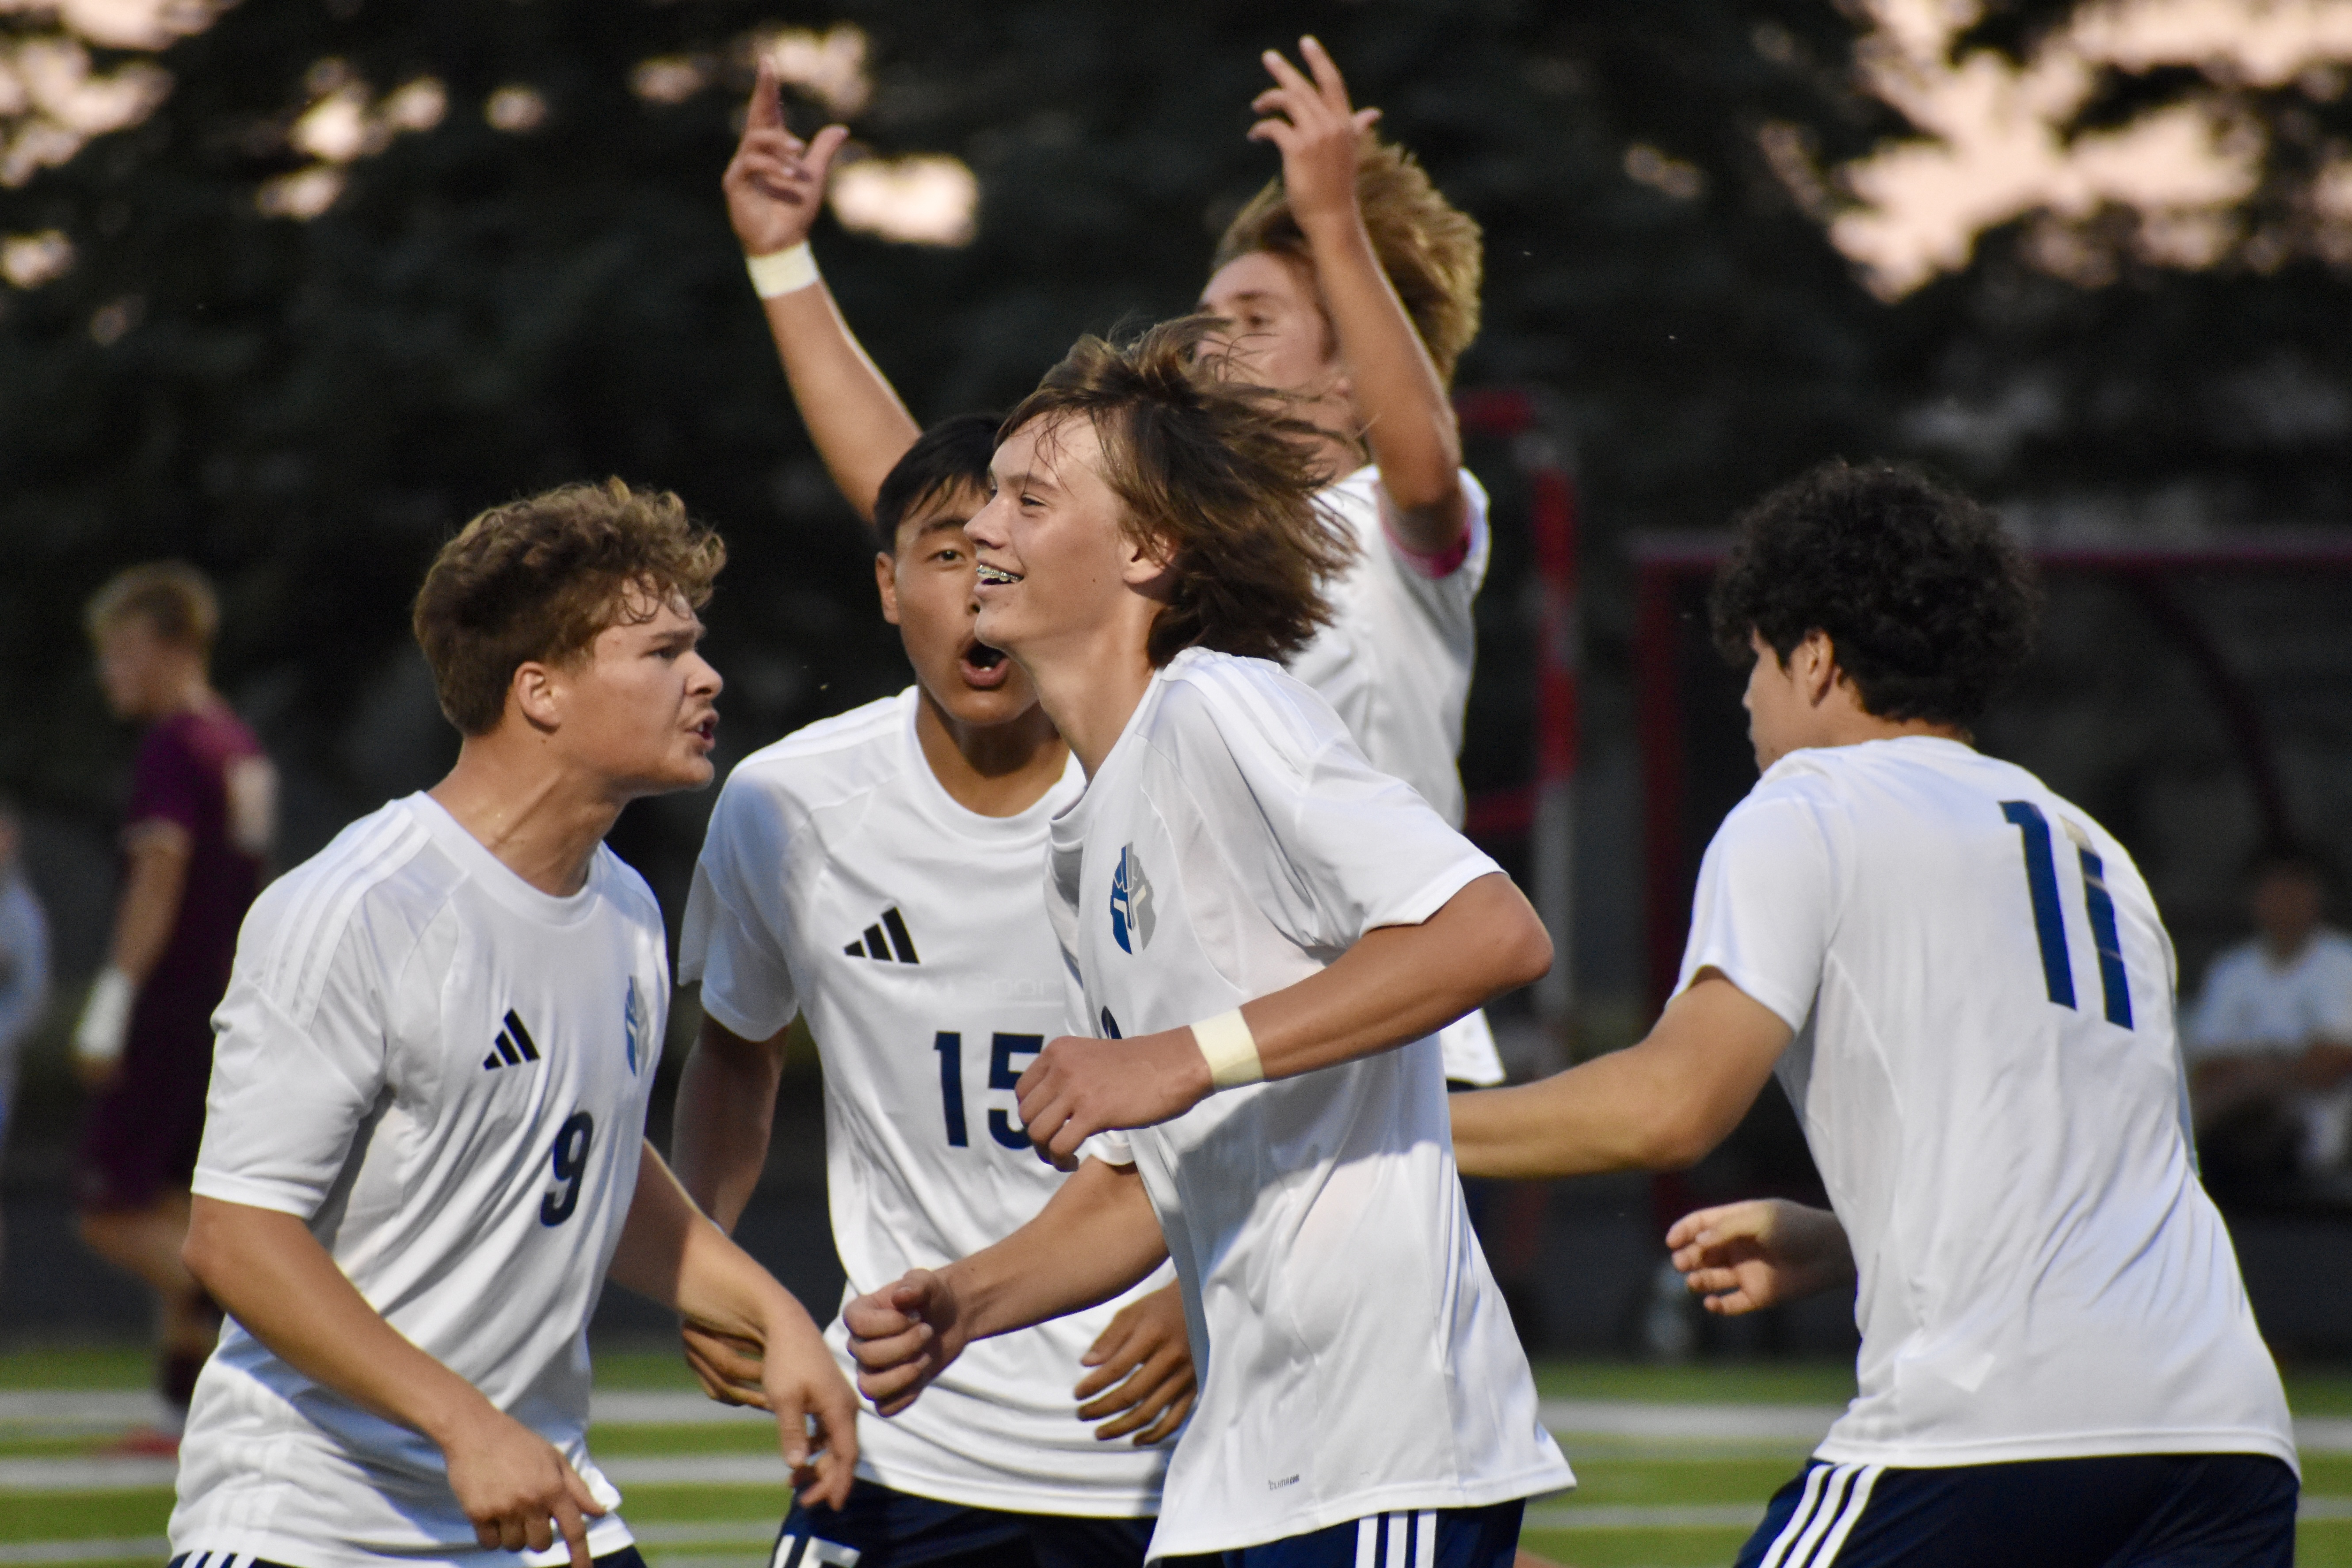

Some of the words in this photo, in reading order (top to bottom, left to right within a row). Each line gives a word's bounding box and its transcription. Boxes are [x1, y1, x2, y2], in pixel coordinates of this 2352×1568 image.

[1997, 800, 2134, 1032] 11
[934, 1030, 1044, 1150] 15
[540, 1111, 594, 1227] 9
